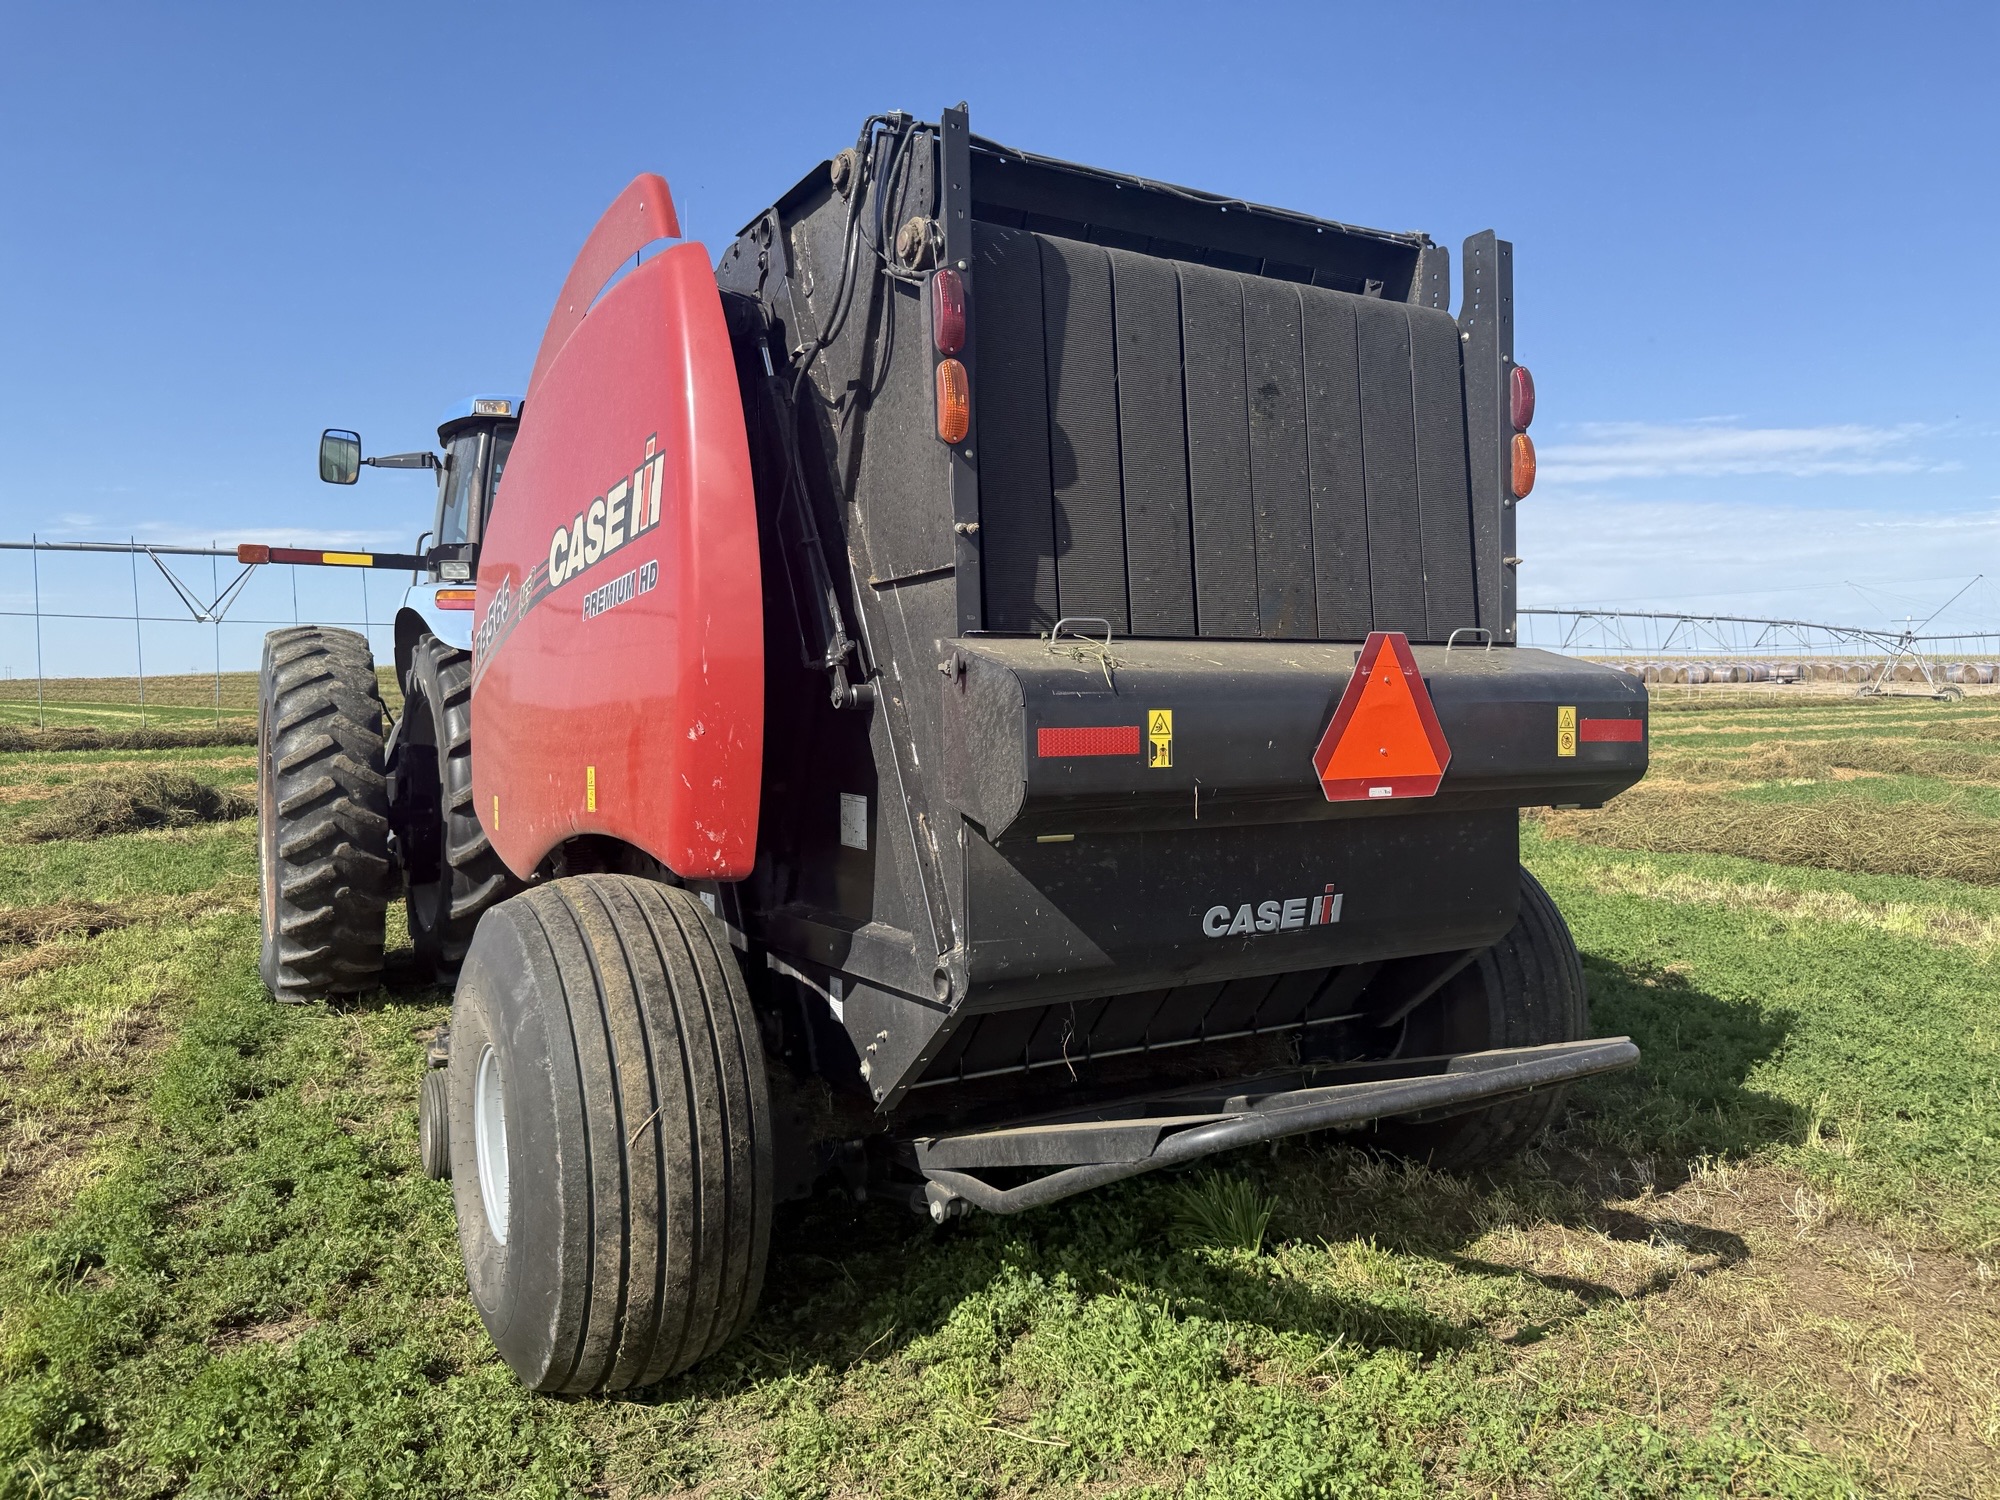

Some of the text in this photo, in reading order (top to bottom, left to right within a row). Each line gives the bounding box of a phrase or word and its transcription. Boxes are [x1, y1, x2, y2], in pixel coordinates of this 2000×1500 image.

[549, 479, 627, 587] CASE
[474, 571, 510, 670] RB565
[583, 569, 636, 622] PREMIUM
[638, 559, 658, 595] HD
[1202, 897, 1307, 938] CASE
